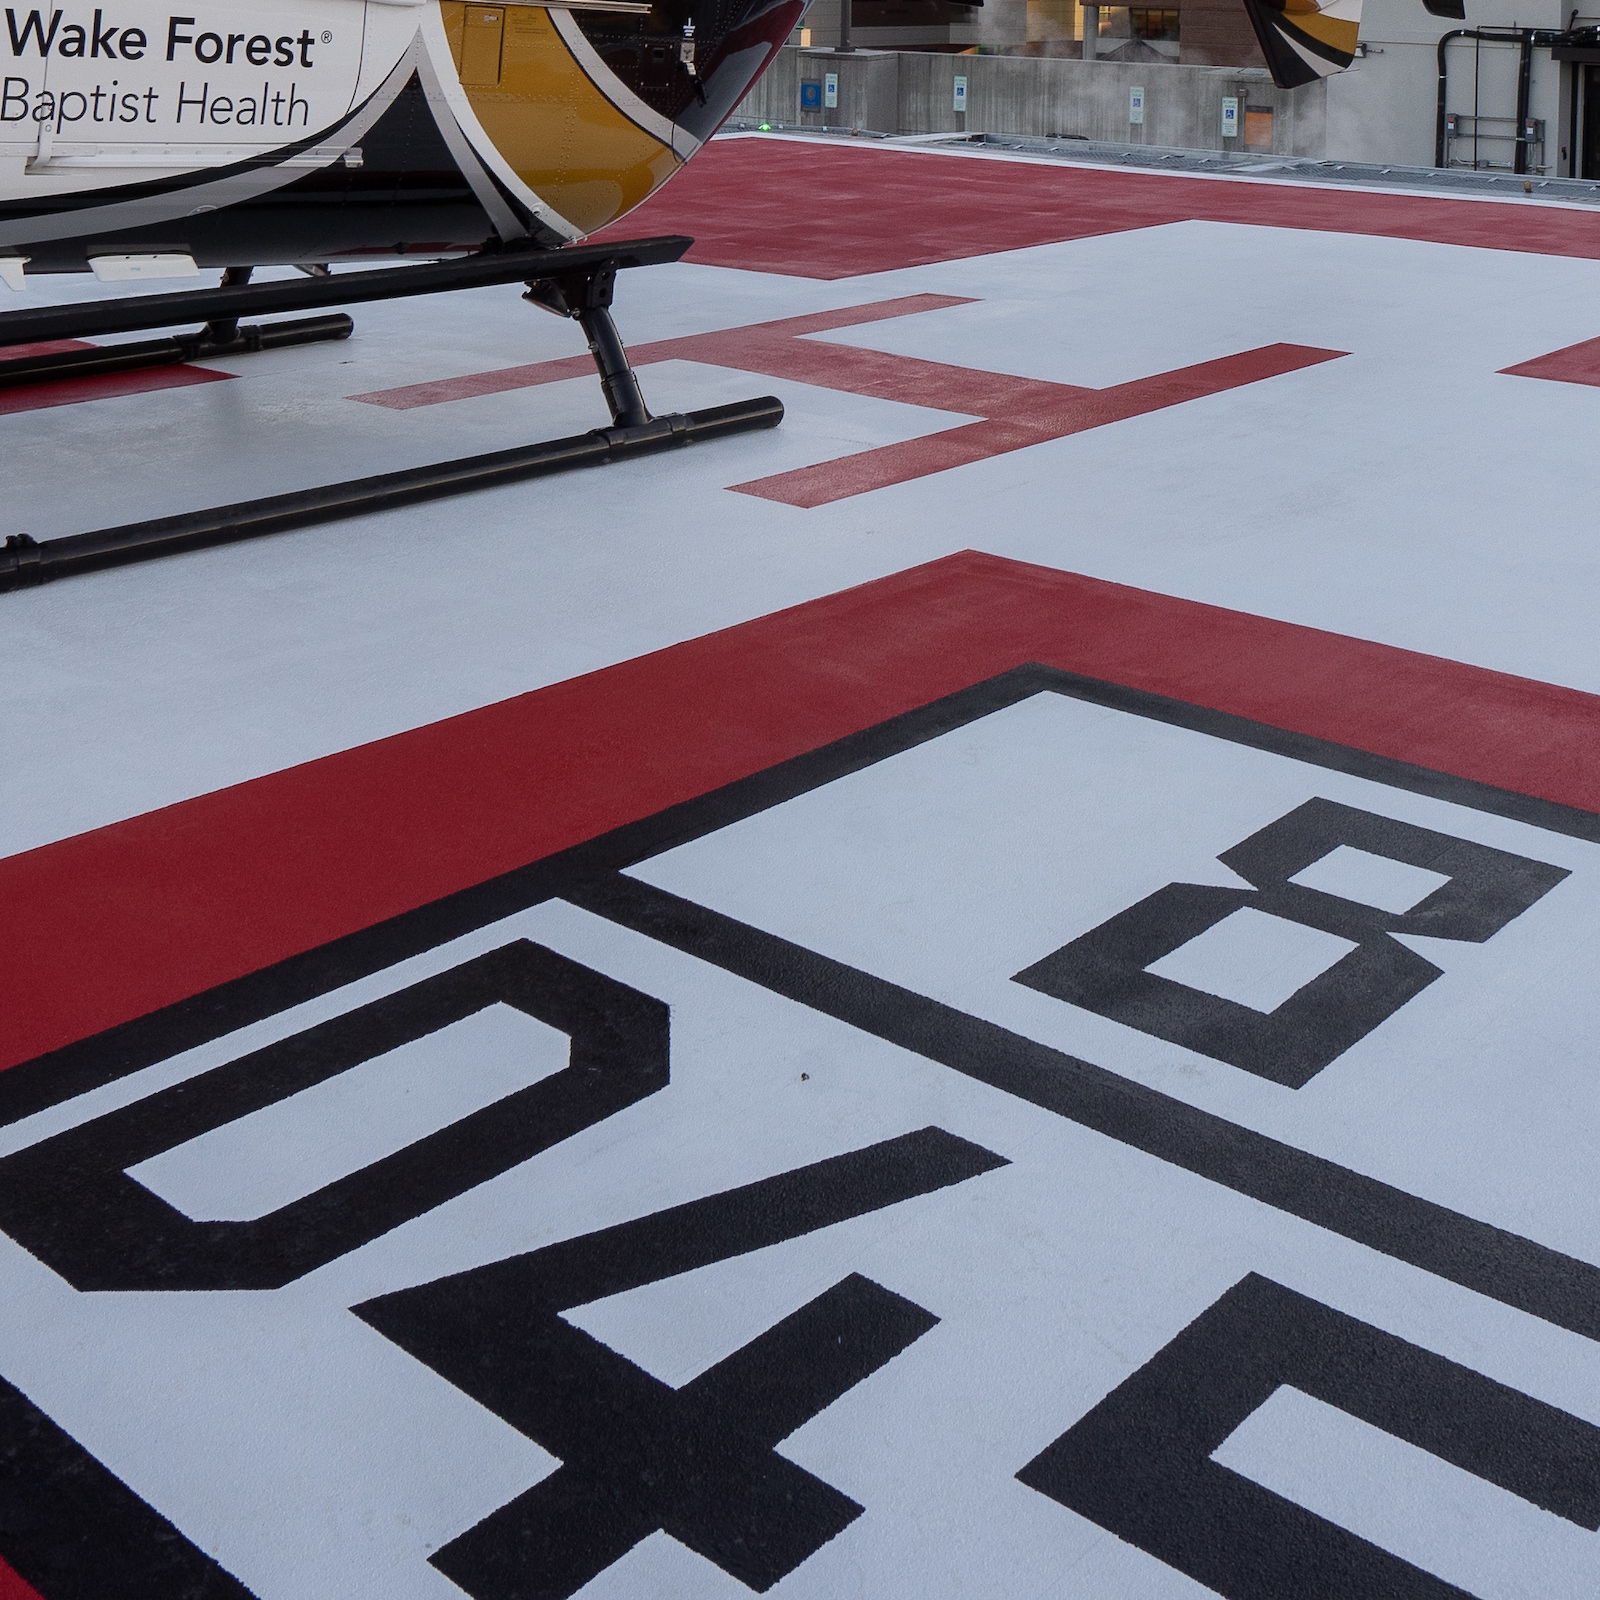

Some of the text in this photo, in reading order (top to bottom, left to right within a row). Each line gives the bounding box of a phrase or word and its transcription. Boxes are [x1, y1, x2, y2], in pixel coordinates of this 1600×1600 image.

[5, 8, 147, 60] Wake
[0, 76, 310, 134] Baptist Health
[1009, 796, 1572, 1089] 8
